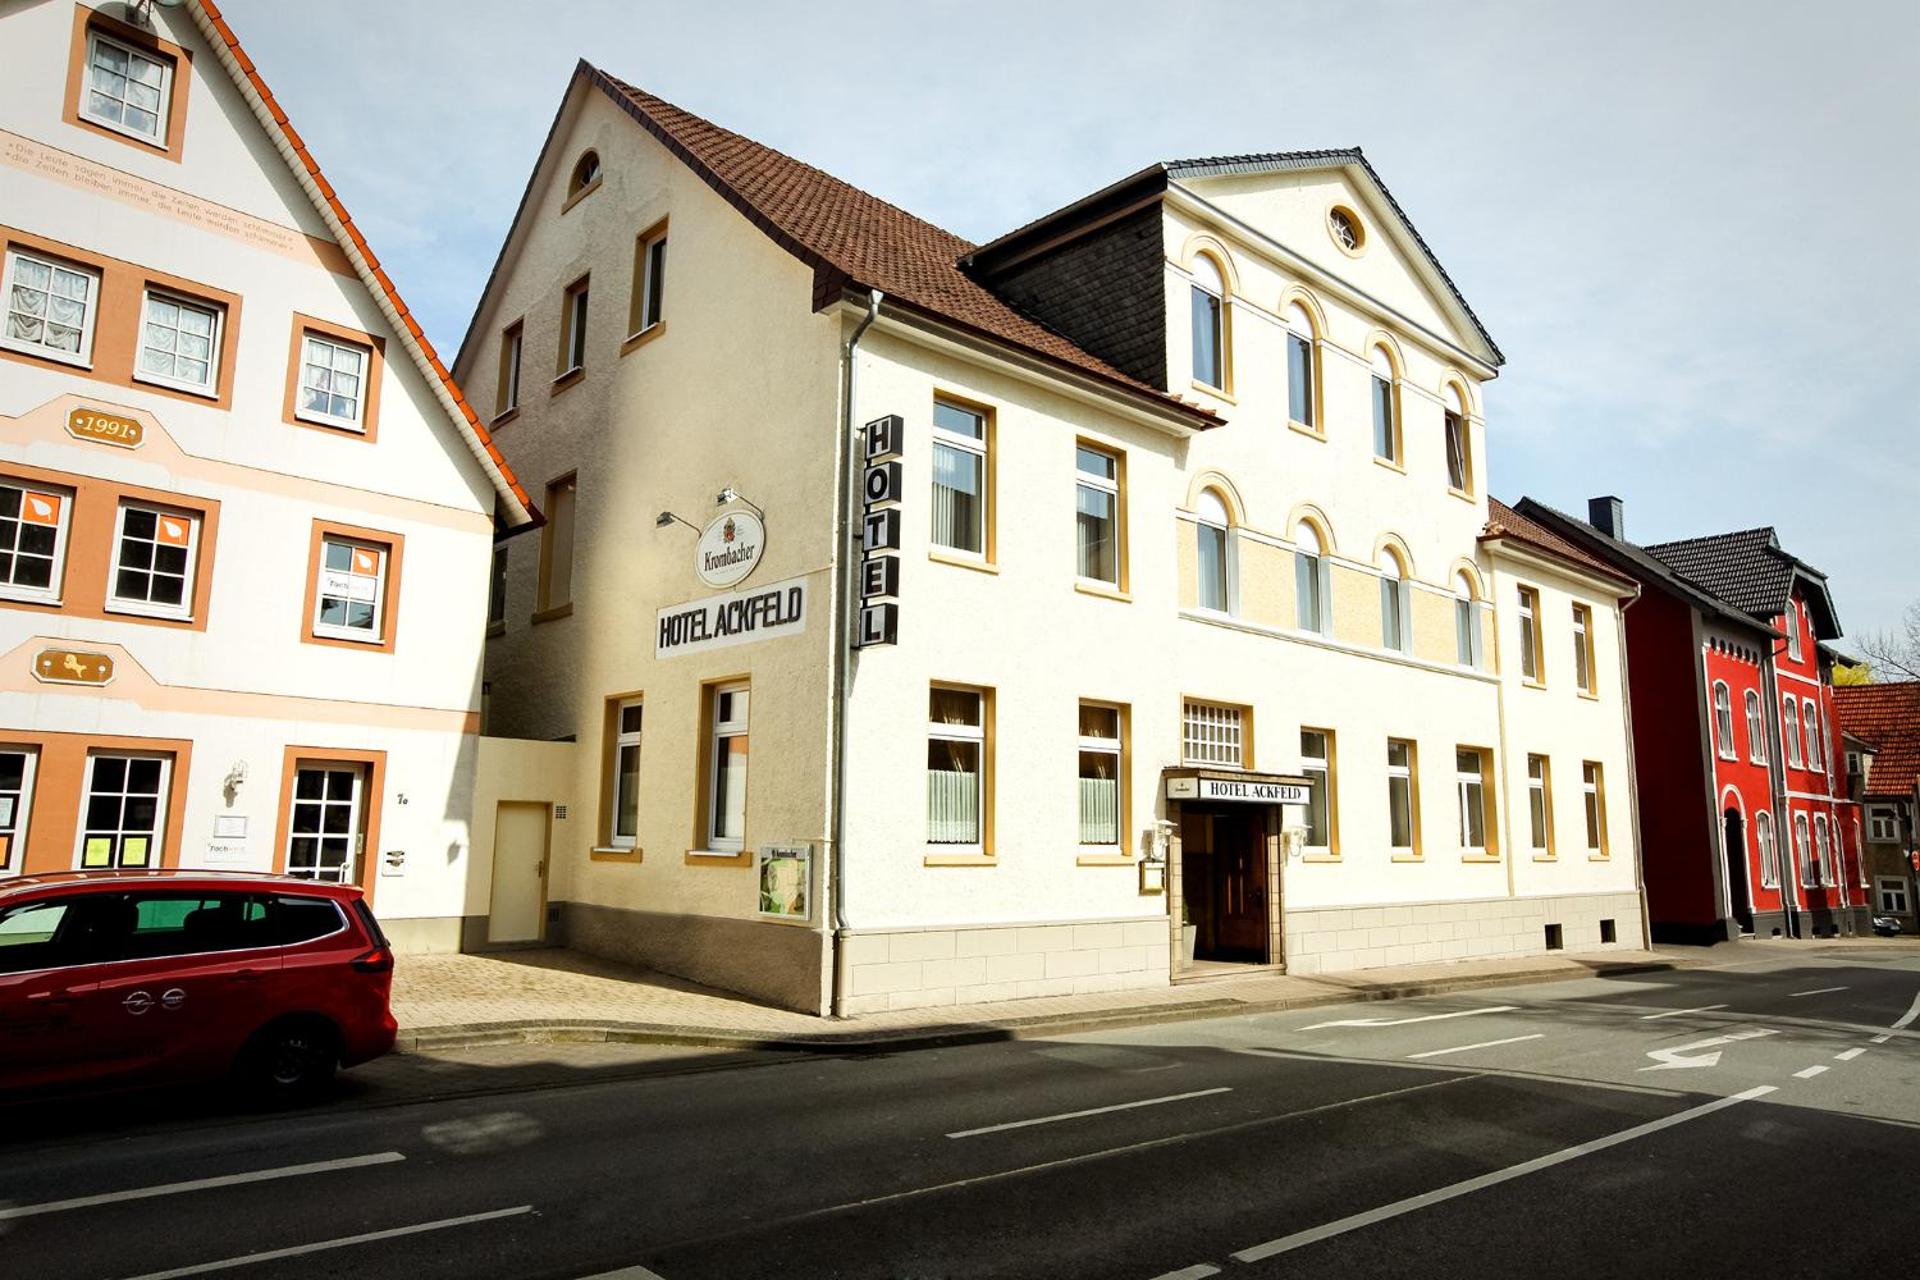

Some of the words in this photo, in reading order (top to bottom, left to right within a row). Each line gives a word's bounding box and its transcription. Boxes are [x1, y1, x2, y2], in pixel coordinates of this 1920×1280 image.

[83, 416, 130, 438] 1991
[863, 420, 890, 642] HOTEL
[704, 541, 755, 572] Krombacher
[659, 607, 713, 649] HOTEL
[713, 586, 803, 638] ACKFELD
[1210, 782, 1249, 797] HOTEL
[1251, 785, 1301, 800] ACKFELD
